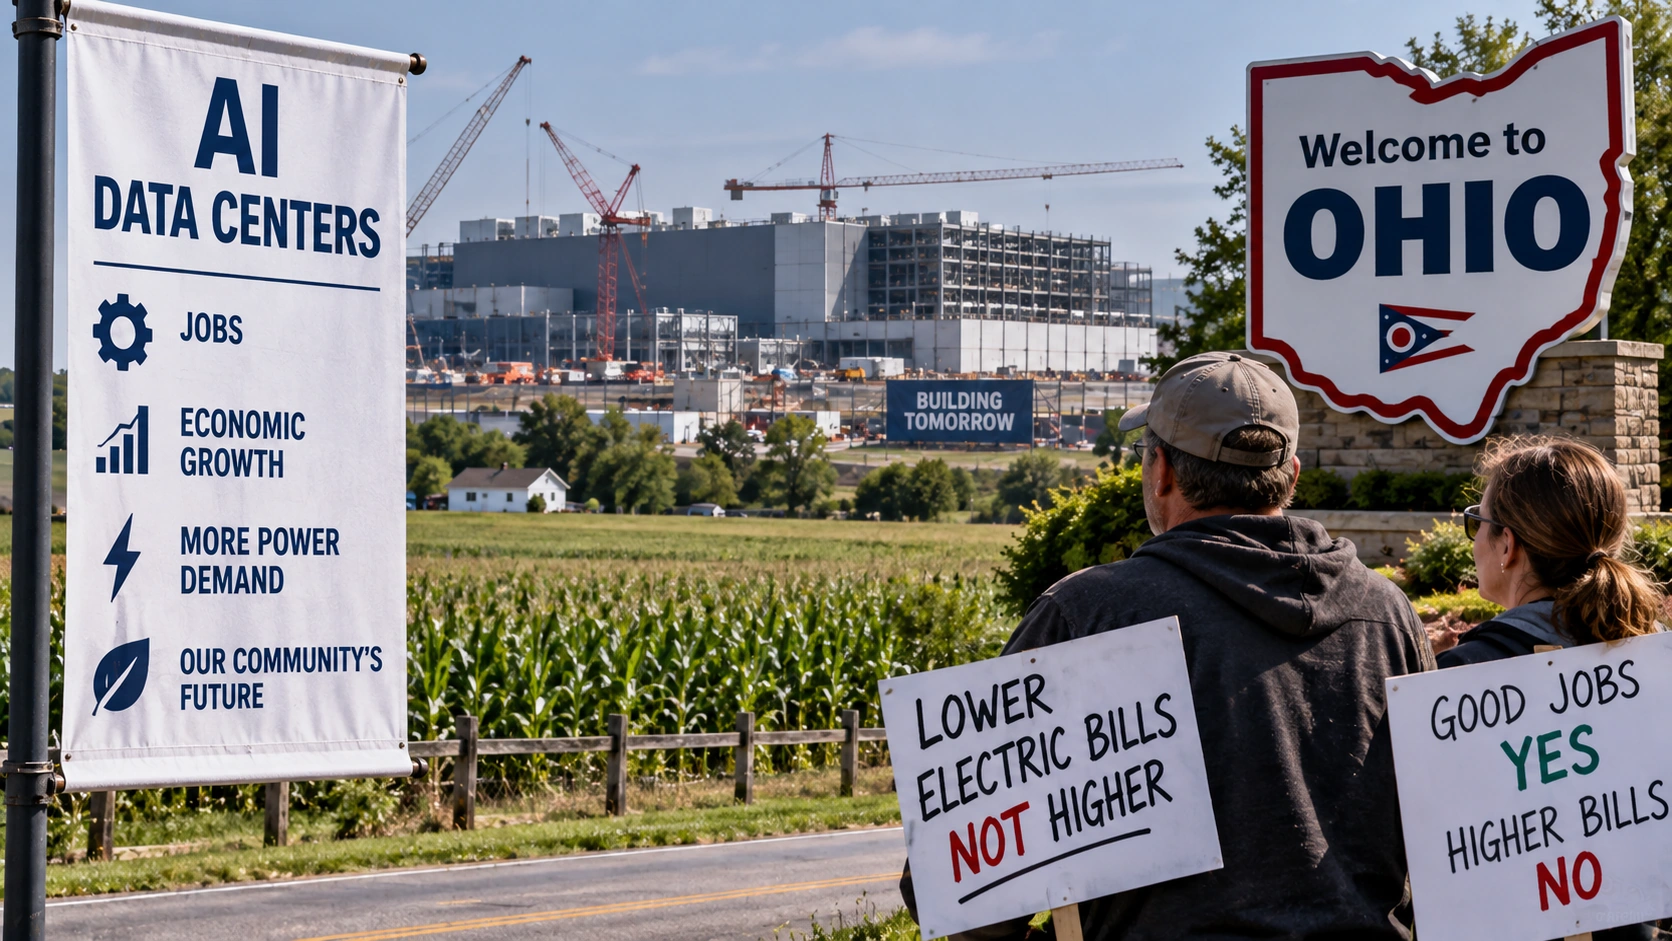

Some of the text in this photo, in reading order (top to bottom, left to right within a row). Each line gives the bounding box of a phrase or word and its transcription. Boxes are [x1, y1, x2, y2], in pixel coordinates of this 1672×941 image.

[194, 77, 278, 178] AI
[1299, 123, 1545, 168] Welcome to
[95, 175, 380, 258] DATA CENTERS
[1284, 175, 1591, 280] OHIO
[180, 312, 242, 344] JOBS
[181, 408, 305, 440] ECONOMIC
[904, 412, 1014, 431] TOMORROW
[917, 392, 1002, 409] BUILDING
[181, 447, 283, 478] GROWTH
[181, 526, 339, 555] MORE POWER
[181, 566, 283, 594] DEMAND
[181, 648, 225, 674] OUR
[181, 683, 263, 710] FUTURE
[916, 674, 1053, 750] LOWER
[1431, 660, 1639, 741] GOOD JOBS
[917, 693, 1177, 822] ELECTRIC BILLS
[1500, 724, 1600, 791] YES
[950, 759, 1173, 883] NOT HIGHER
[1447, 780, 1668, 873] HIGHER BILLS
[1537, 851, 1602, 911] NO
